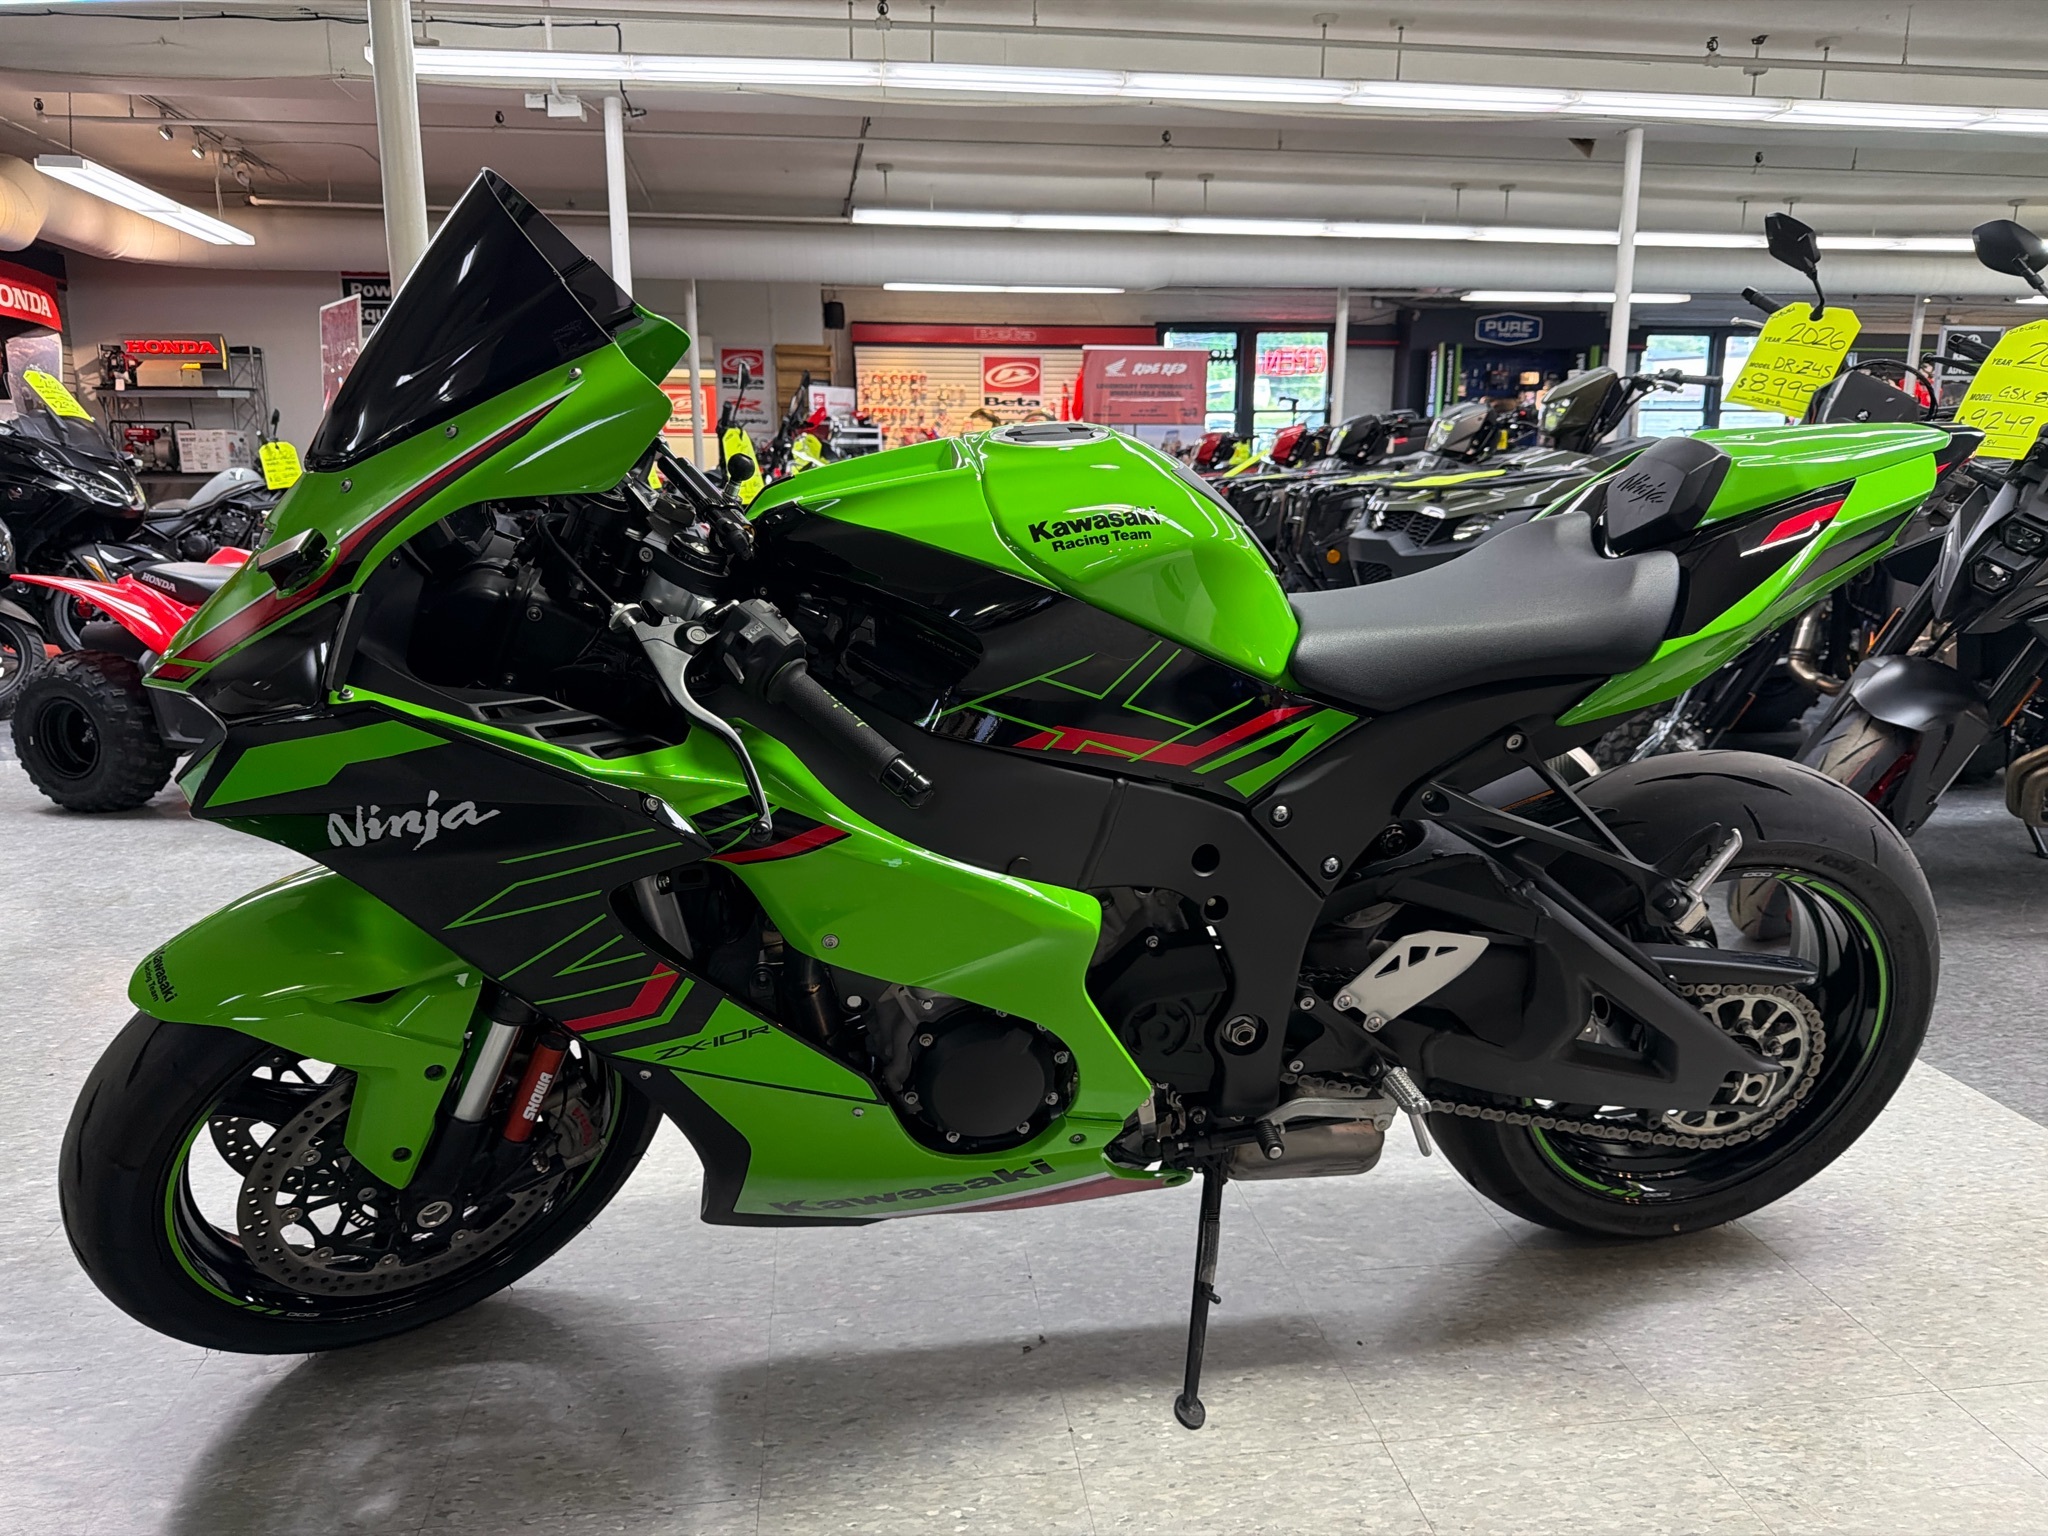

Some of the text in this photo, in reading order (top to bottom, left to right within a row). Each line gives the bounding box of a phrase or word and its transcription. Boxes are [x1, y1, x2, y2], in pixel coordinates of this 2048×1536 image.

[973, 327, 1037, 341] Beta
[1484, 320, 1534, 333] PURE
[1785, 323, 1846, 350] 2026
[124, 340, 219, 354] HONDA
[1749, 362, 1771, 370] MODEL
[1991, 358, 2013, 367] YEAR
[984, 397, 1040, 407] Beta
[1969, 393, 1992, 402] MODEL
[1998, 386, 2031, 401] GSX
[1027, 506, 1161, 543] Kawasaki
[1052, 529, 1152, 552] Racing Team
[141, 572, 177, 593] HONDA
[327, 790, 501, 851] Ninja
[153, 949, 178, 1003] Kawasaki
[148, 980, 159, 1002] Team
[654, 1025, 773, 1061] ZX-10R
[522, 1072, 553, 1121] SHOWA
[769, 1158, 1057, 1214] Kawasaki
